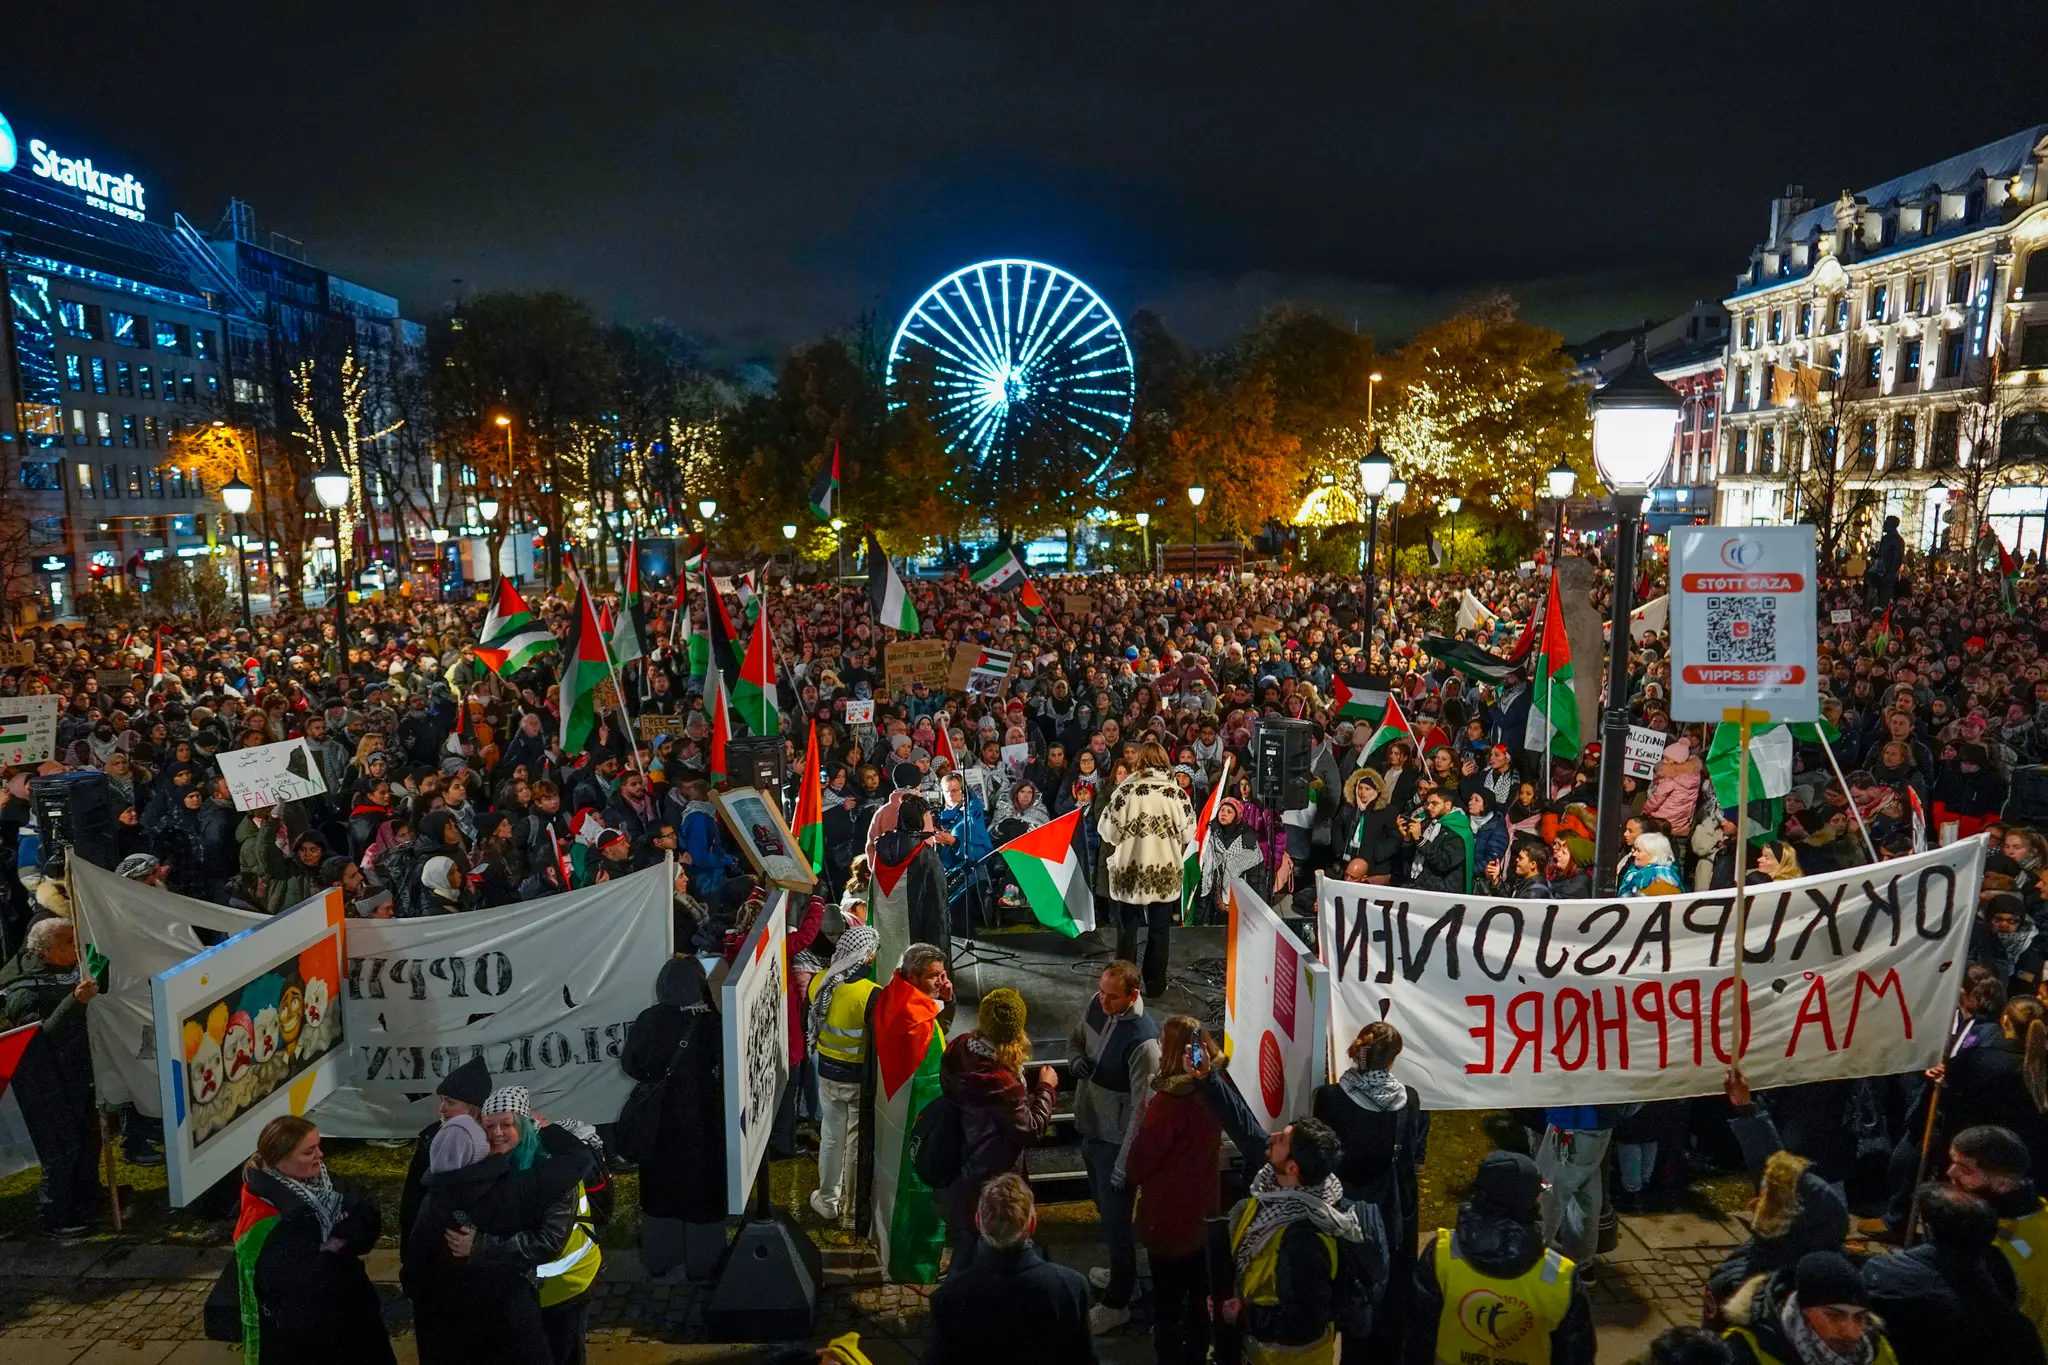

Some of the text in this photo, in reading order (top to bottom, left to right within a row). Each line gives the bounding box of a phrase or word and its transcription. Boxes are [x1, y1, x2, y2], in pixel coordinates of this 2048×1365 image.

[30, 139, 146, 210] Statkraft
[1973, 279, 1988, 355] HOTEL
[1697, 578, 1791, 591] STØTT GAZA
[1698, 670, 1793, 682] VIPPS: 8590
[643, 717, 665, 726] FREE
[1627, 731, 1664, 747] ALESTINA
[253, 776, 269, 784] WILL
[242, 777, 324, 809] FALASTIN
